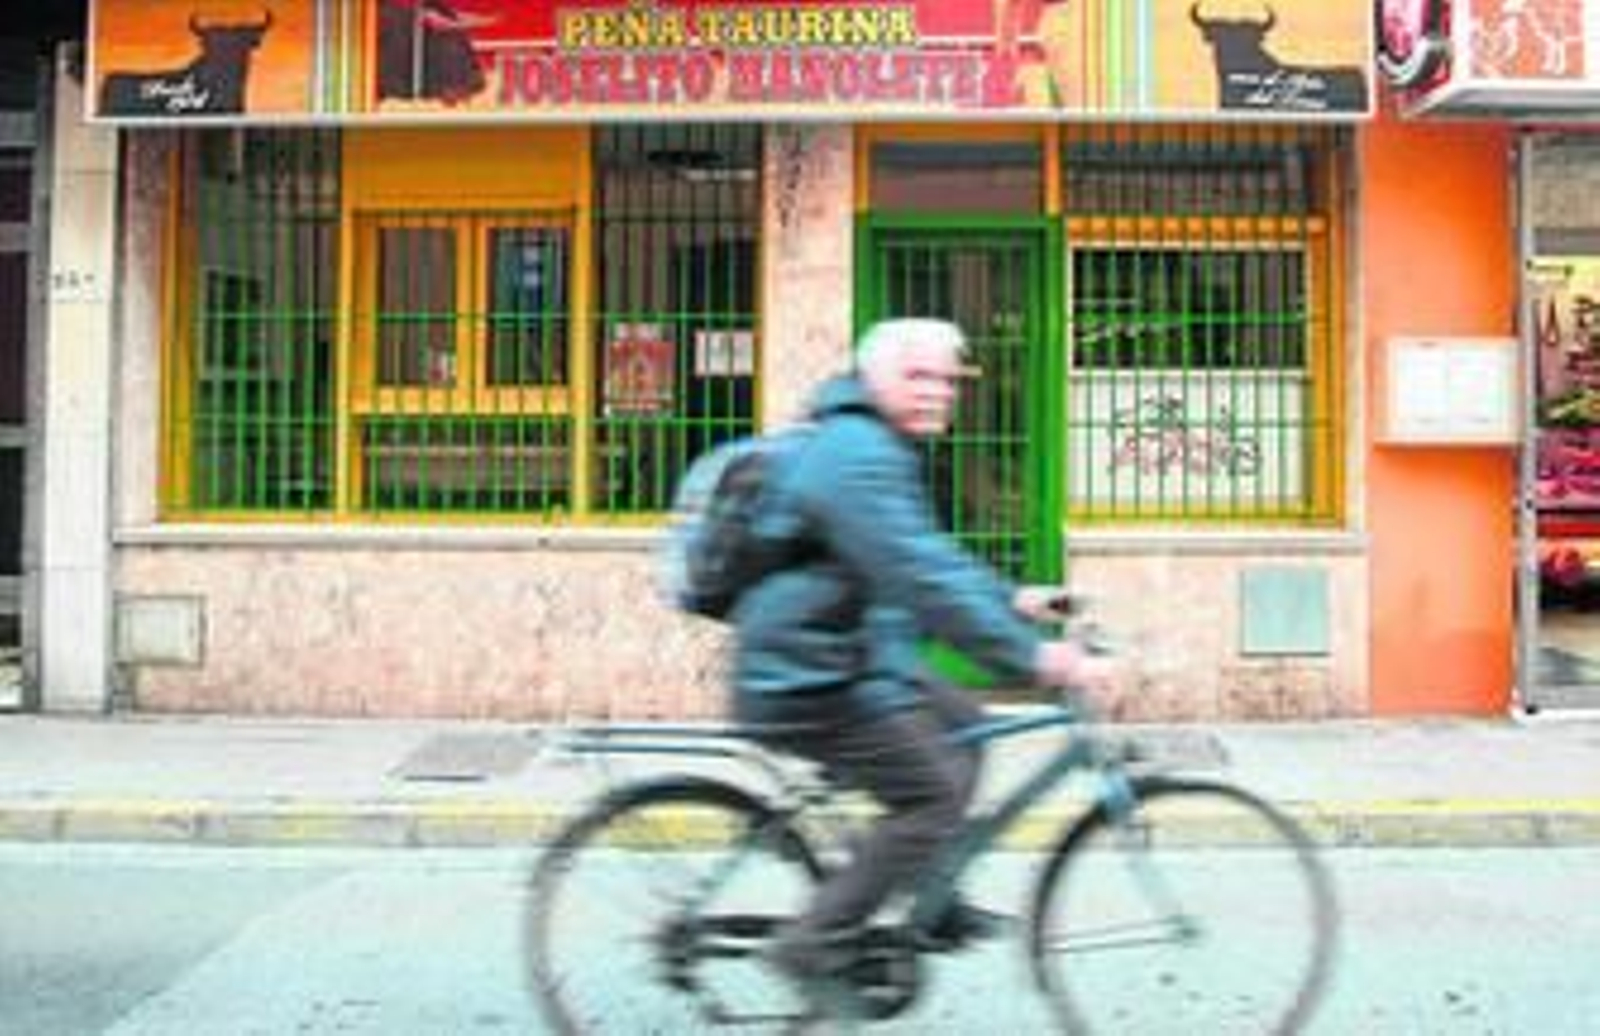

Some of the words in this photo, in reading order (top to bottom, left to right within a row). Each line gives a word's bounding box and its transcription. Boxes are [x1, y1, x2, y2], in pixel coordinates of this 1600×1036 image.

[561, 3, 688, 49] PEÑA
[696, 6, 917, 48] TAURINA
[499, 51, 716, 104] JOSELITO
